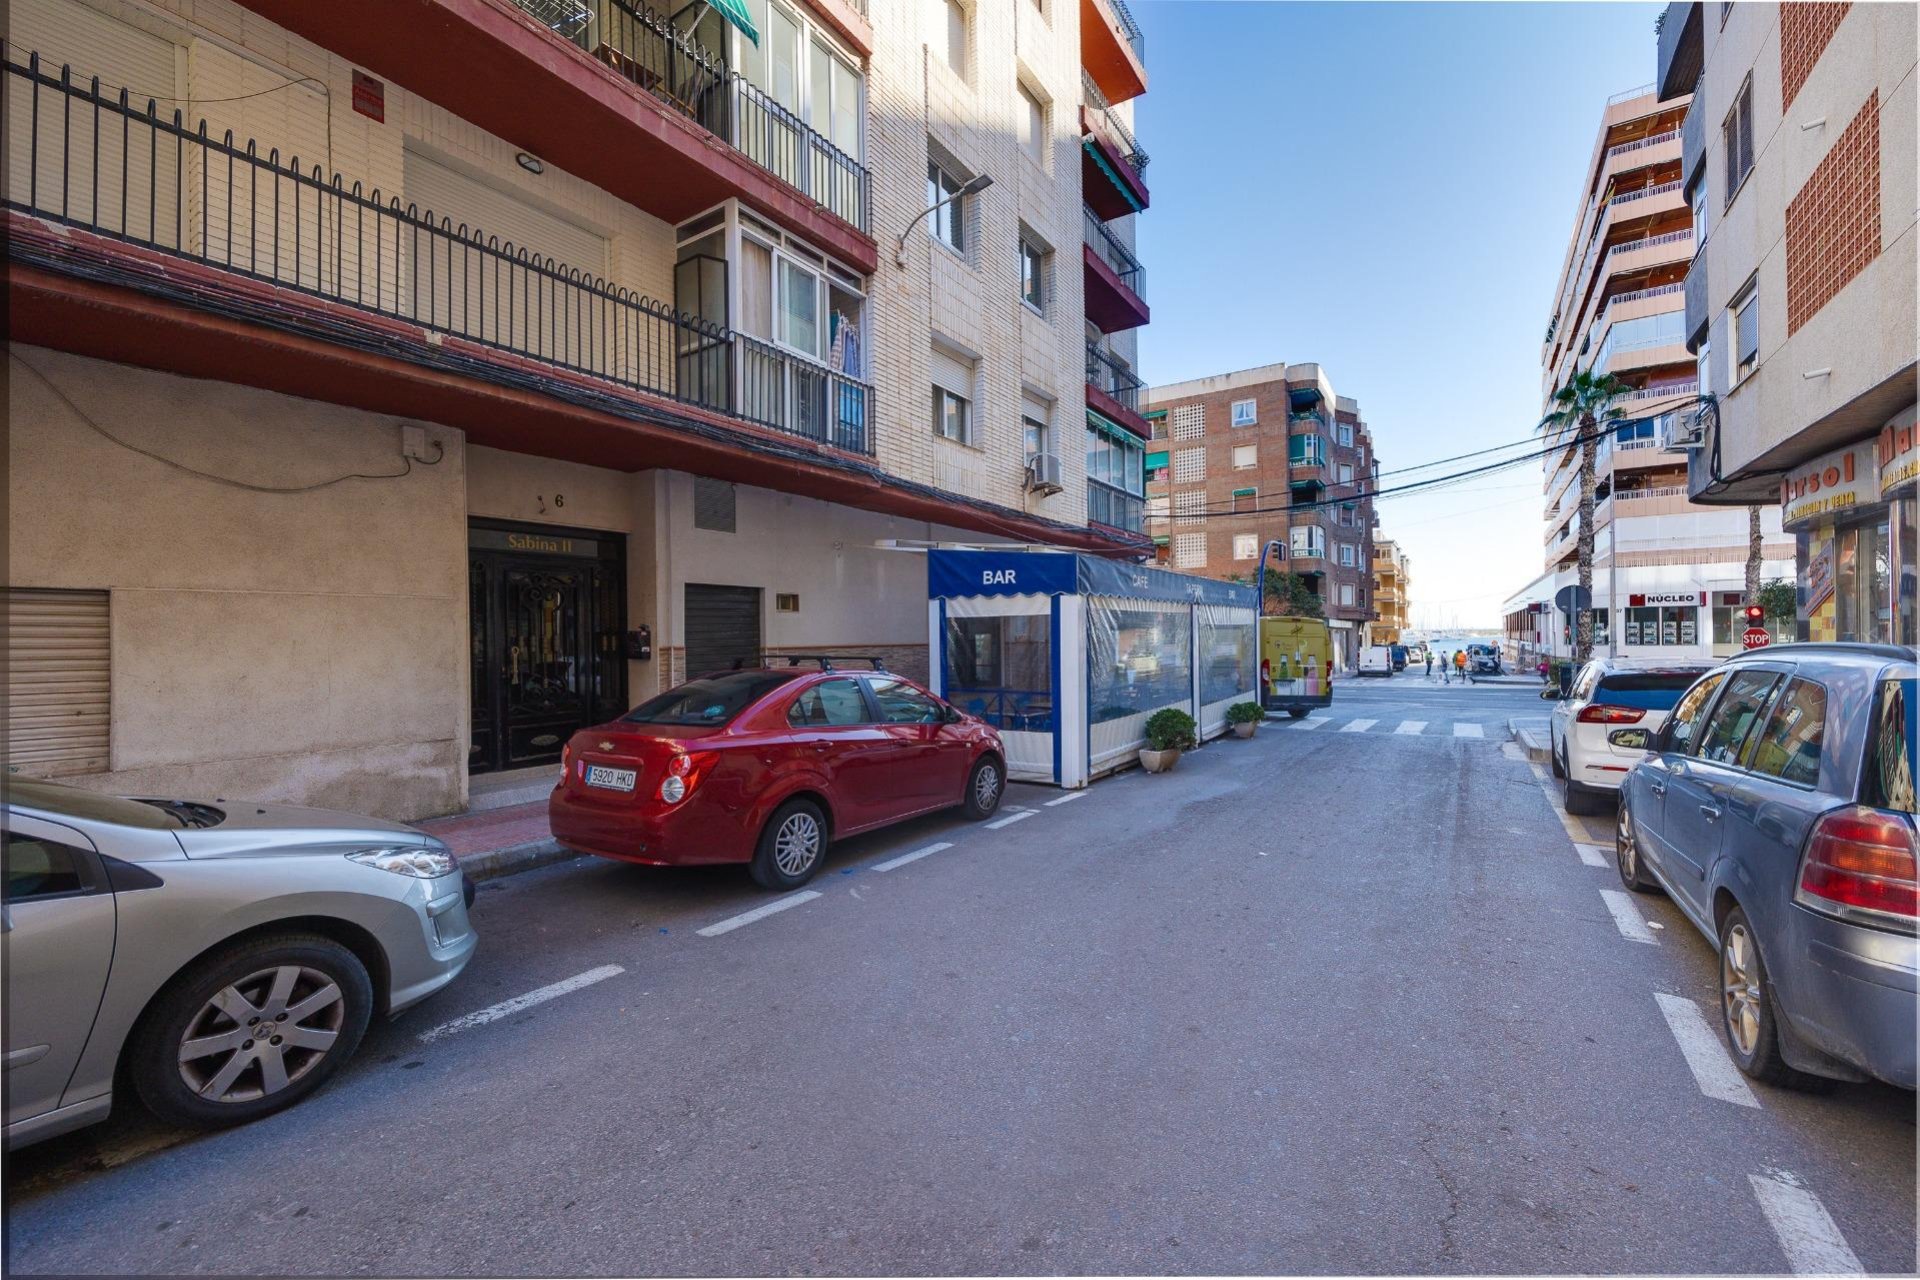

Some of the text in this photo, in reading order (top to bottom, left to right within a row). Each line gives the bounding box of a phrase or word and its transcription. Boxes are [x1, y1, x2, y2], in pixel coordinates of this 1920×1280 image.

[555, 494, 564, 508] 6
[507, 533, 557, 551] Sabina
[983, 569, 1016, 585] BAR
[1647, 593, 1695, 603] NÚCLEO
[1743, 633, 1769, 644] STOP
[593, 768, 613, 784] 5920
